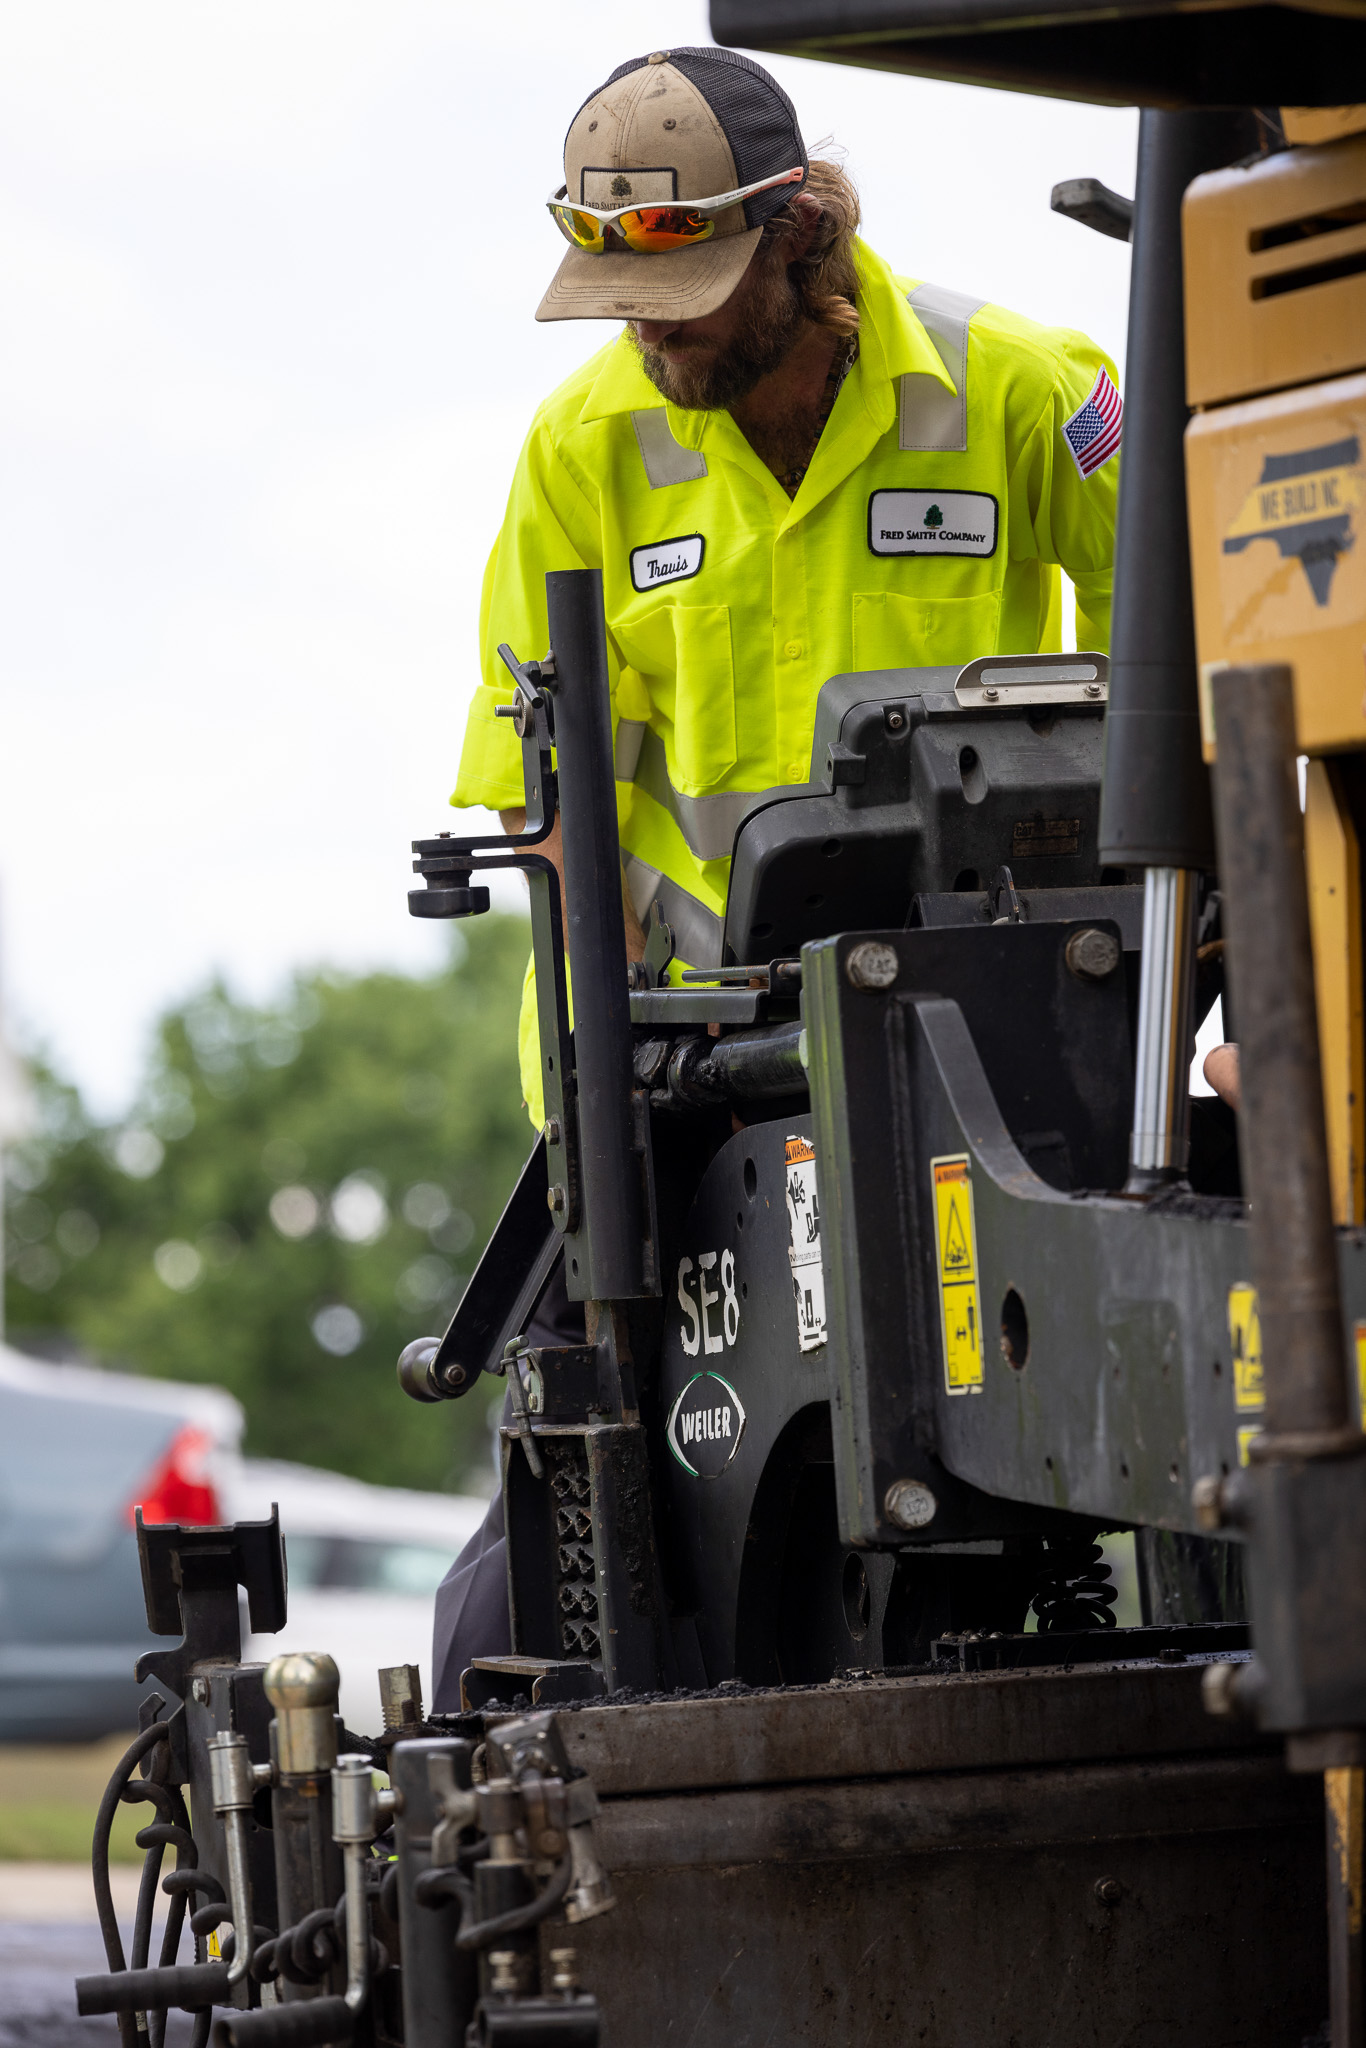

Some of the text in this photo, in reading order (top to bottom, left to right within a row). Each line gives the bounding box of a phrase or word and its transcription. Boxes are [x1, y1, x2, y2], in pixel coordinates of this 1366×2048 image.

[585, 200, 600, 209] FRED
[601, 201, 625, 210] SMITH
[1259, 489, 1279, 521] WE
[1283, 482, 1317, 517] BUILD
[880, 530, 986, 543] FRED SMITH COMPANY
[647, 555, 689, 579] Travis
[677, 1248, 740, 1357] SE8
[681, 1406, 731, 1445] WEILER
